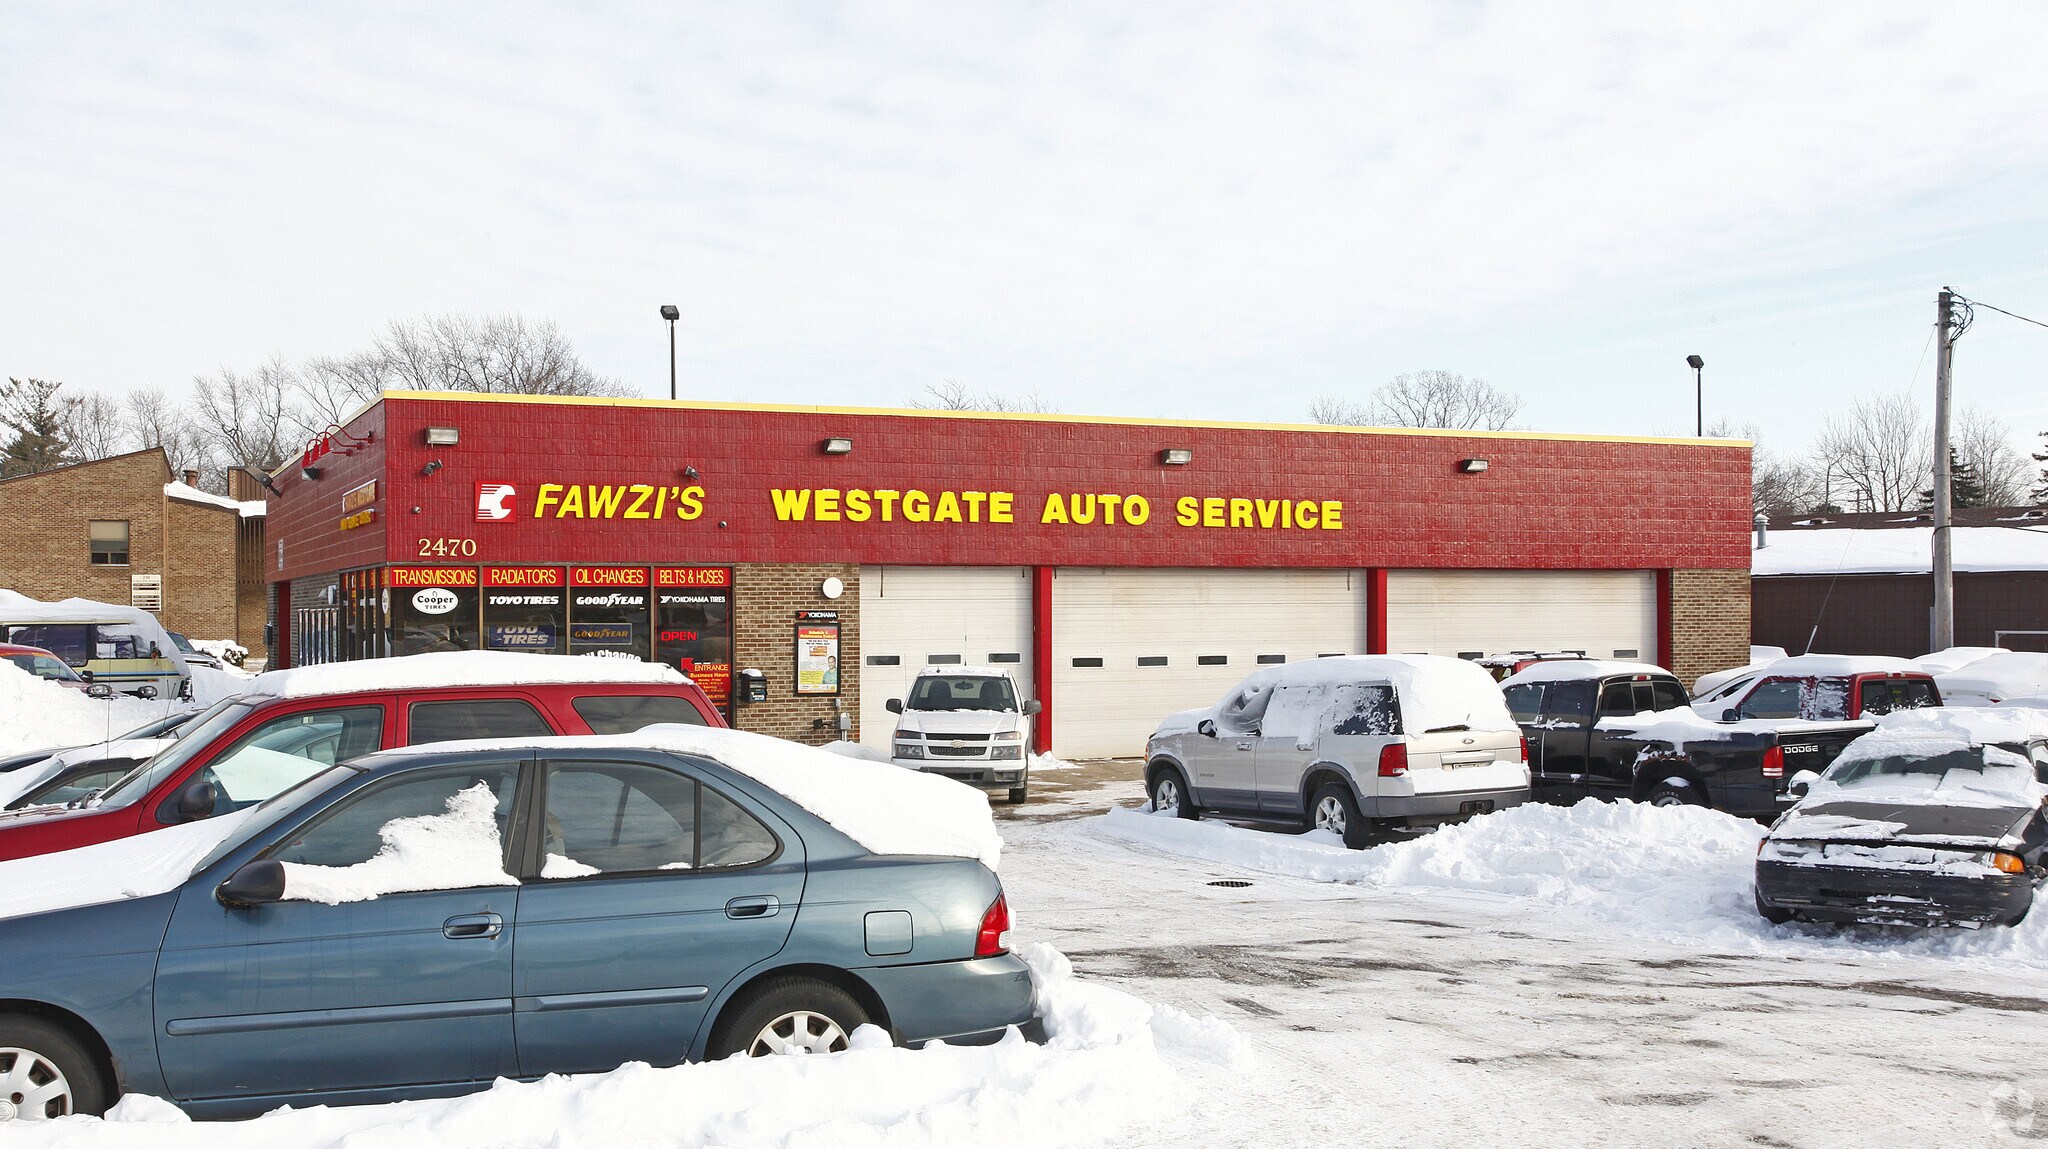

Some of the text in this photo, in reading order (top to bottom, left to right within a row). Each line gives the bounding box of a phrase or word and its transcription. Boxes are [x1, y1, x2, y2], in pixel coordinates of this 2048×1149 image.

[534, 484, 1343, 530] FAWZI'S WESTGATE AUTO SERVICE
[418, 537, 477, 557] 2470
[393, 569, 476, 585] TRANSMISSIONS
[491, 569, 557, 584] RADIATORS
[576, 569, 644, 584] OIL CHANGES
[659, 569, 724, 584] BELTS & HOSES
[417, 595, 454, 606] Cooper
[489, 596, 559, 605] TOYO TIRES
[576, 593, 644, 607] GOODYEAR
[671, 595, 709, 603] YOKOHAMA
[496, 625, 538, 634] TOYO
[575, 628, 629, 639] GOODYEAR
[502, 634, 549, 645] TIRES
[661, 631, 697, 641] OPEN
[1784, 745, 1819, 754] DODGE
